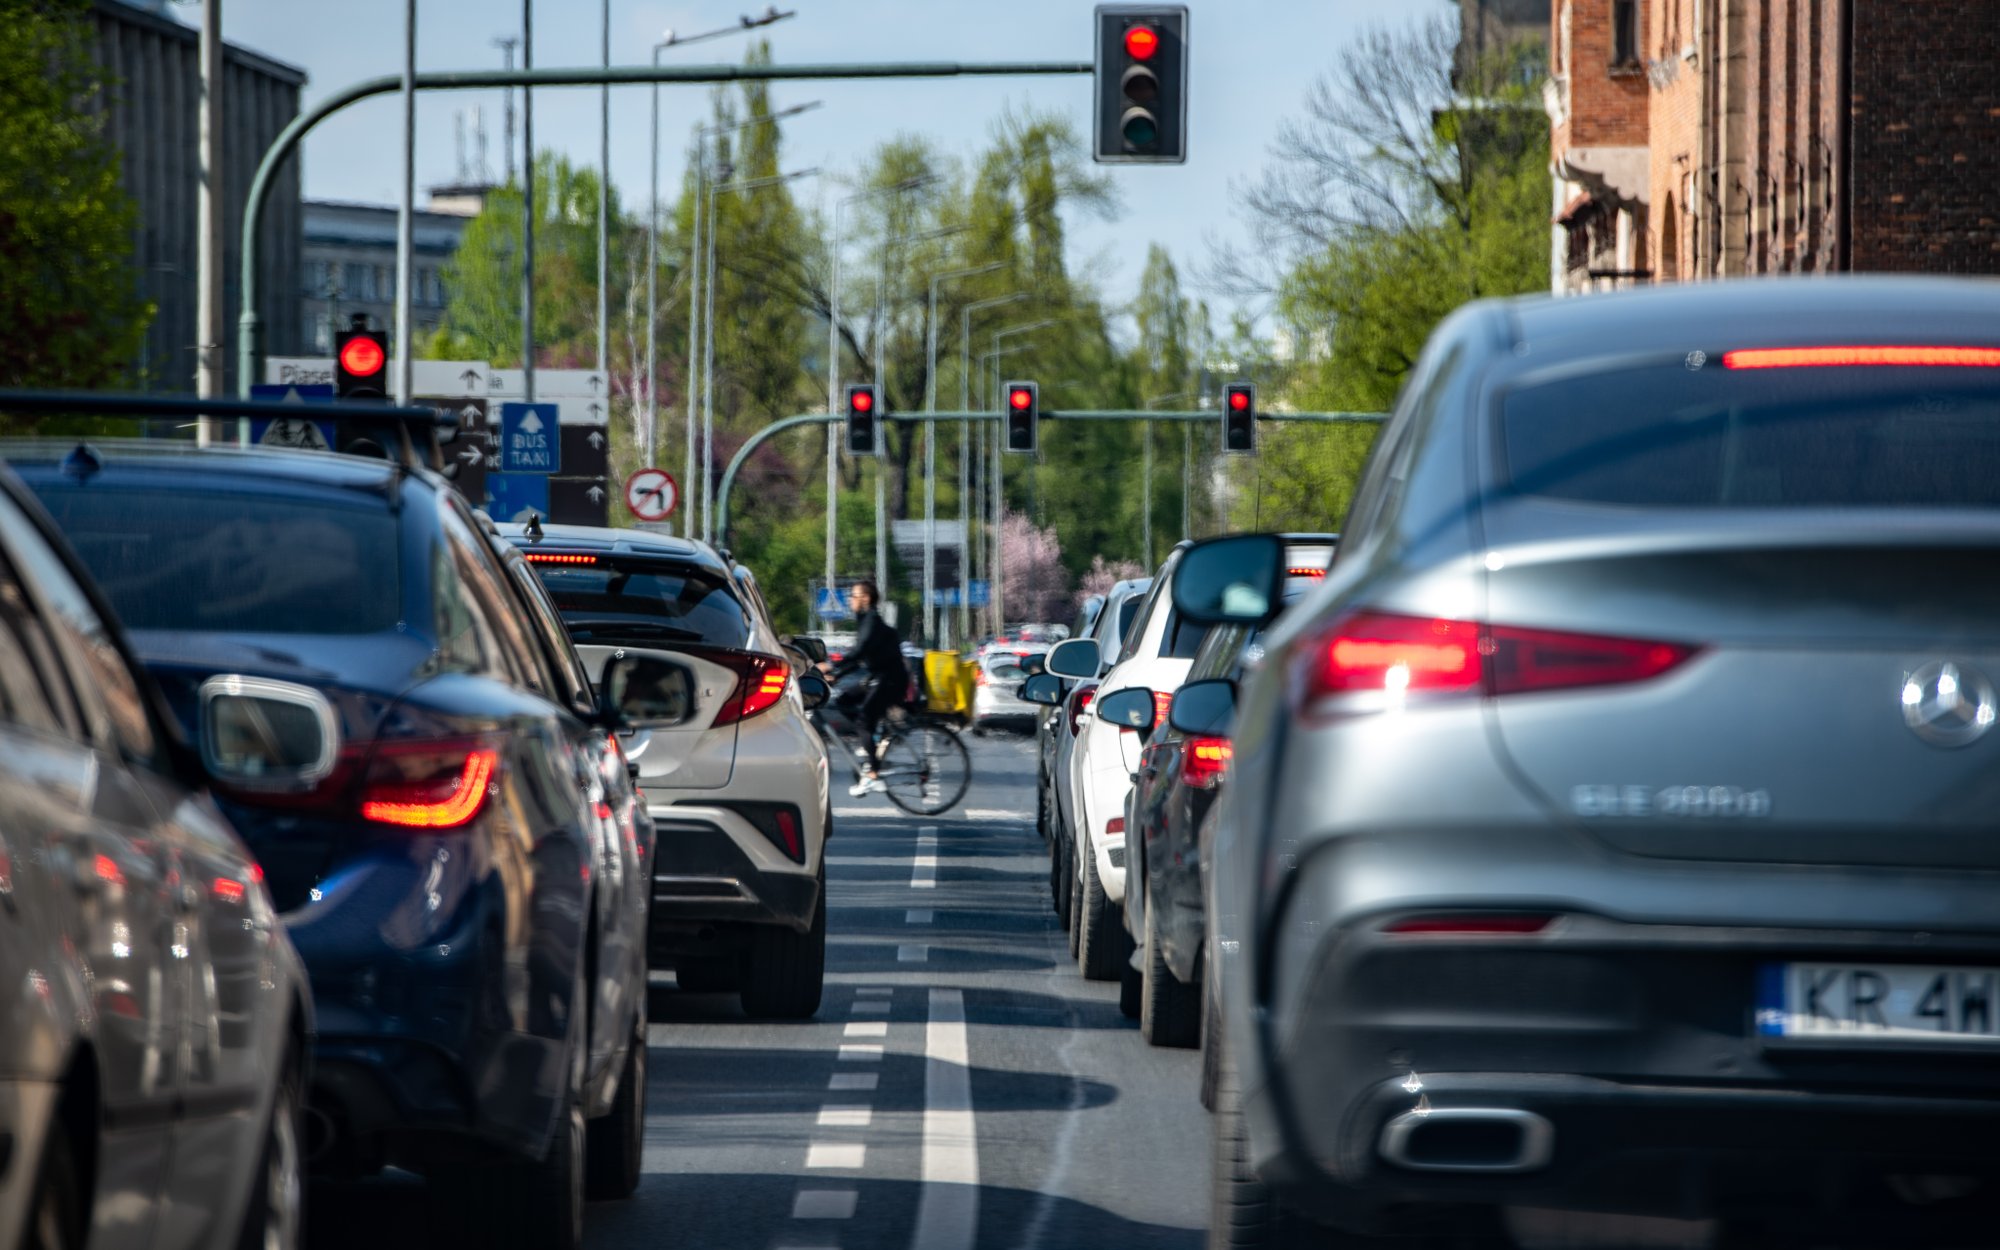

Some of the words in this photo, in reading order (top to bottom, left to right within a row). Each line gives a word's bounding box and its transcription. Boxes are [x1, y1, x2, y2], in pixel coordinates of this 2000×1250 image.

[511, 433, 547, 449] BUS
[510, 450, 550, 466] TAXI
[1801, 969, 1893, 1033] KR
